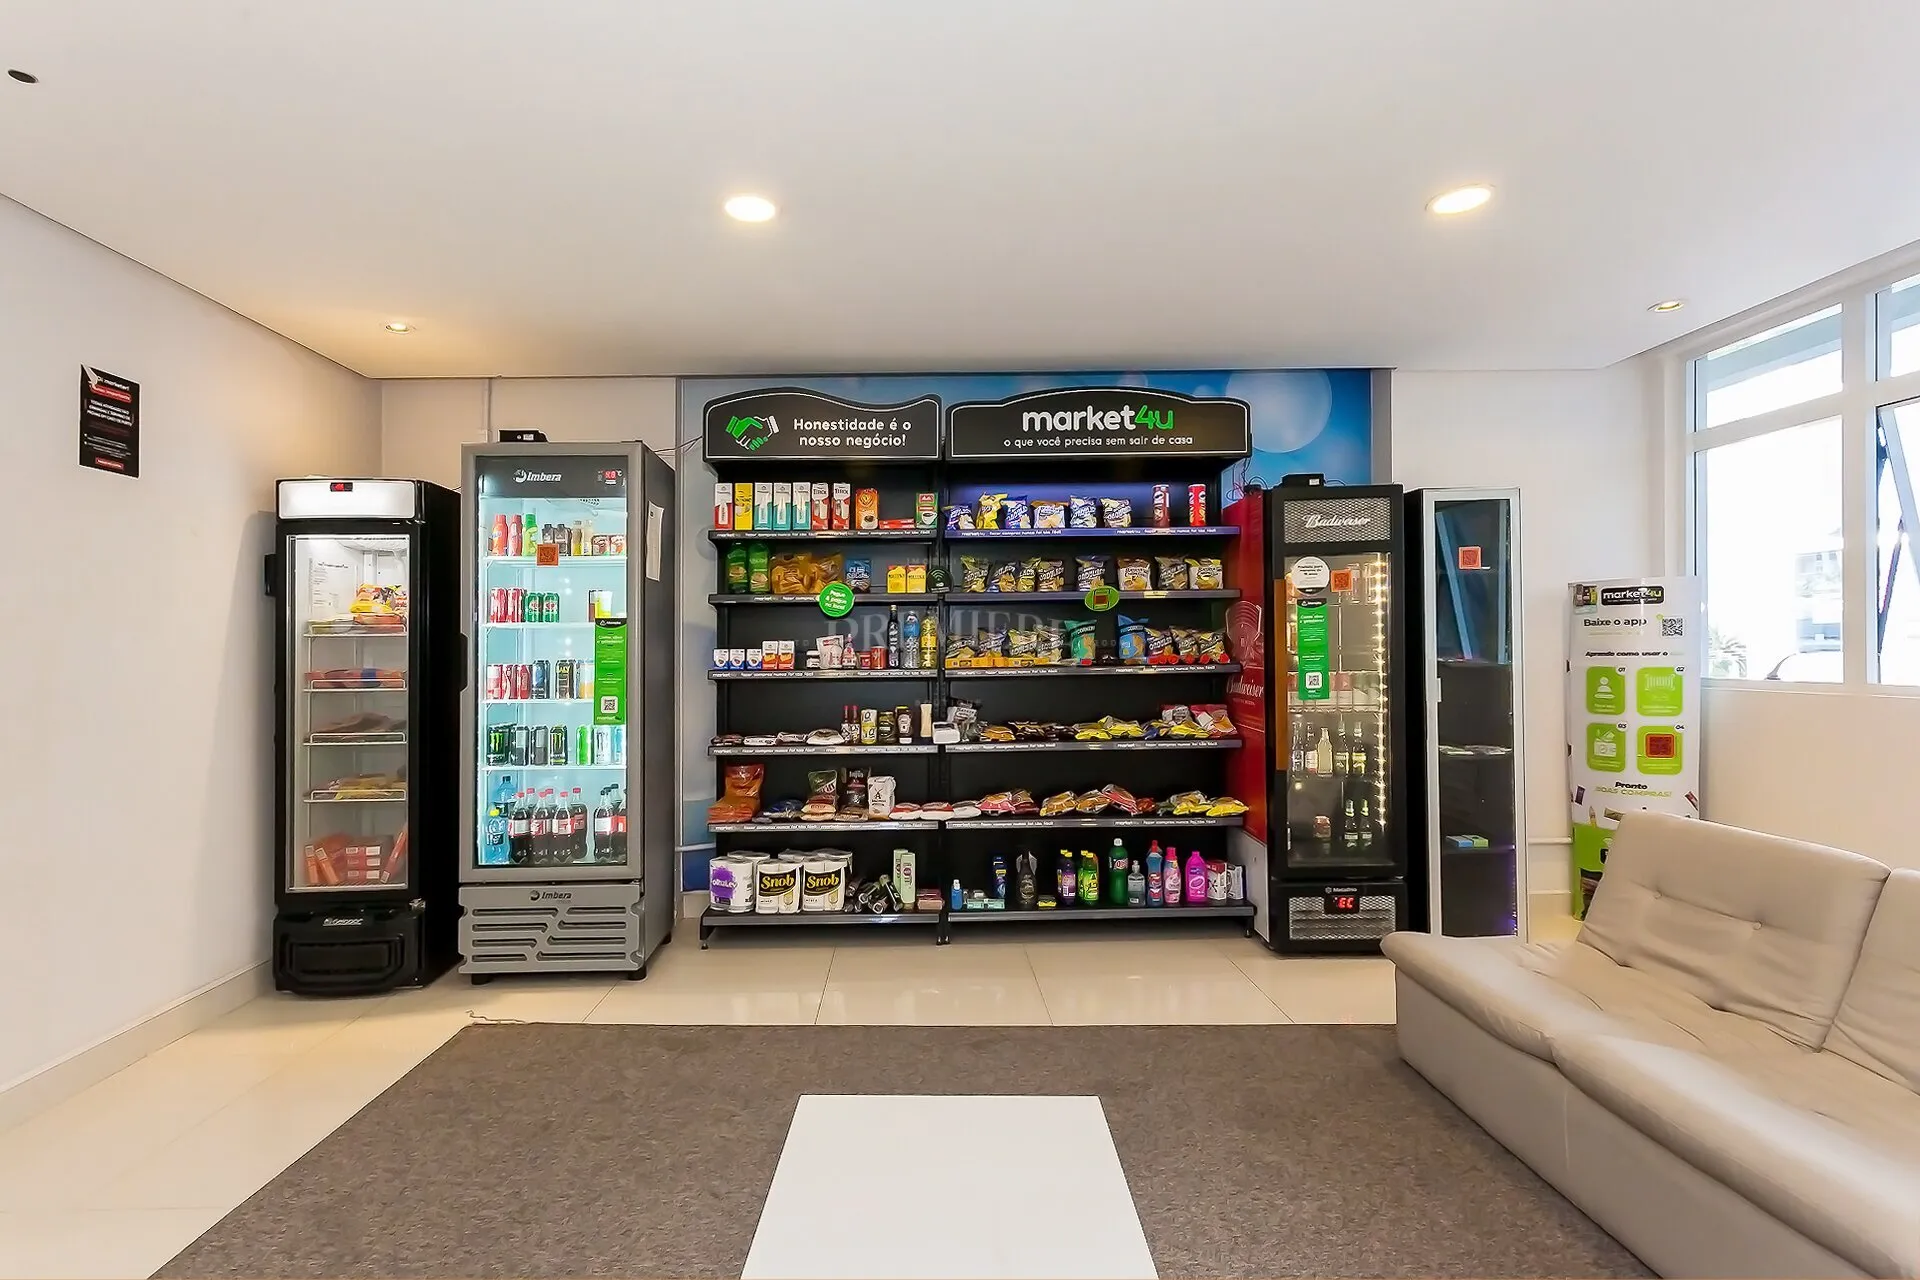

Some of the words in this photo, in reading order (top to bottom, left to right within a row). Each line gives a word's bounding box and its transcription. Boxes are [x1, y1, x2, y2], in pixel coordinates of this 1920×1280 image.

[793, 418, 885, 431] Honestidade
[889, 418, 898, 431] é
[903, 421, 912, 431] o
[1022, 404, 1174, 432] market4u
[799, 435, 841, 447] nosso
[845, 434, 906, 449] negócio!
[1003, 438, 1011, 448] o
[1014, 437, 1034, 449] que
[1036, 436, 1061, 448] você
[1064, 436, 1102, 449] precisa
[1105, 436, 1126, 446] sem
[1128, 434, 1149, 446] sair
[1151, 435, 1166, 446] de
[1168, 436, 1193, 445] casa
[527, 472, 562, 482] Imbera
[1302, 513, 1371, 529] Budweiser
[1602, 588, 1662, 600] market4u
[1583, 618, 1612, 627] Baixe
[1623, 618, 1648, 629] app
[1614, 781, 1648, 790] Pronto
[761, 874, 795, 890] Snob
[806, 873, 840, 889] Snob
[541, 891, 572, 899] Imbera
